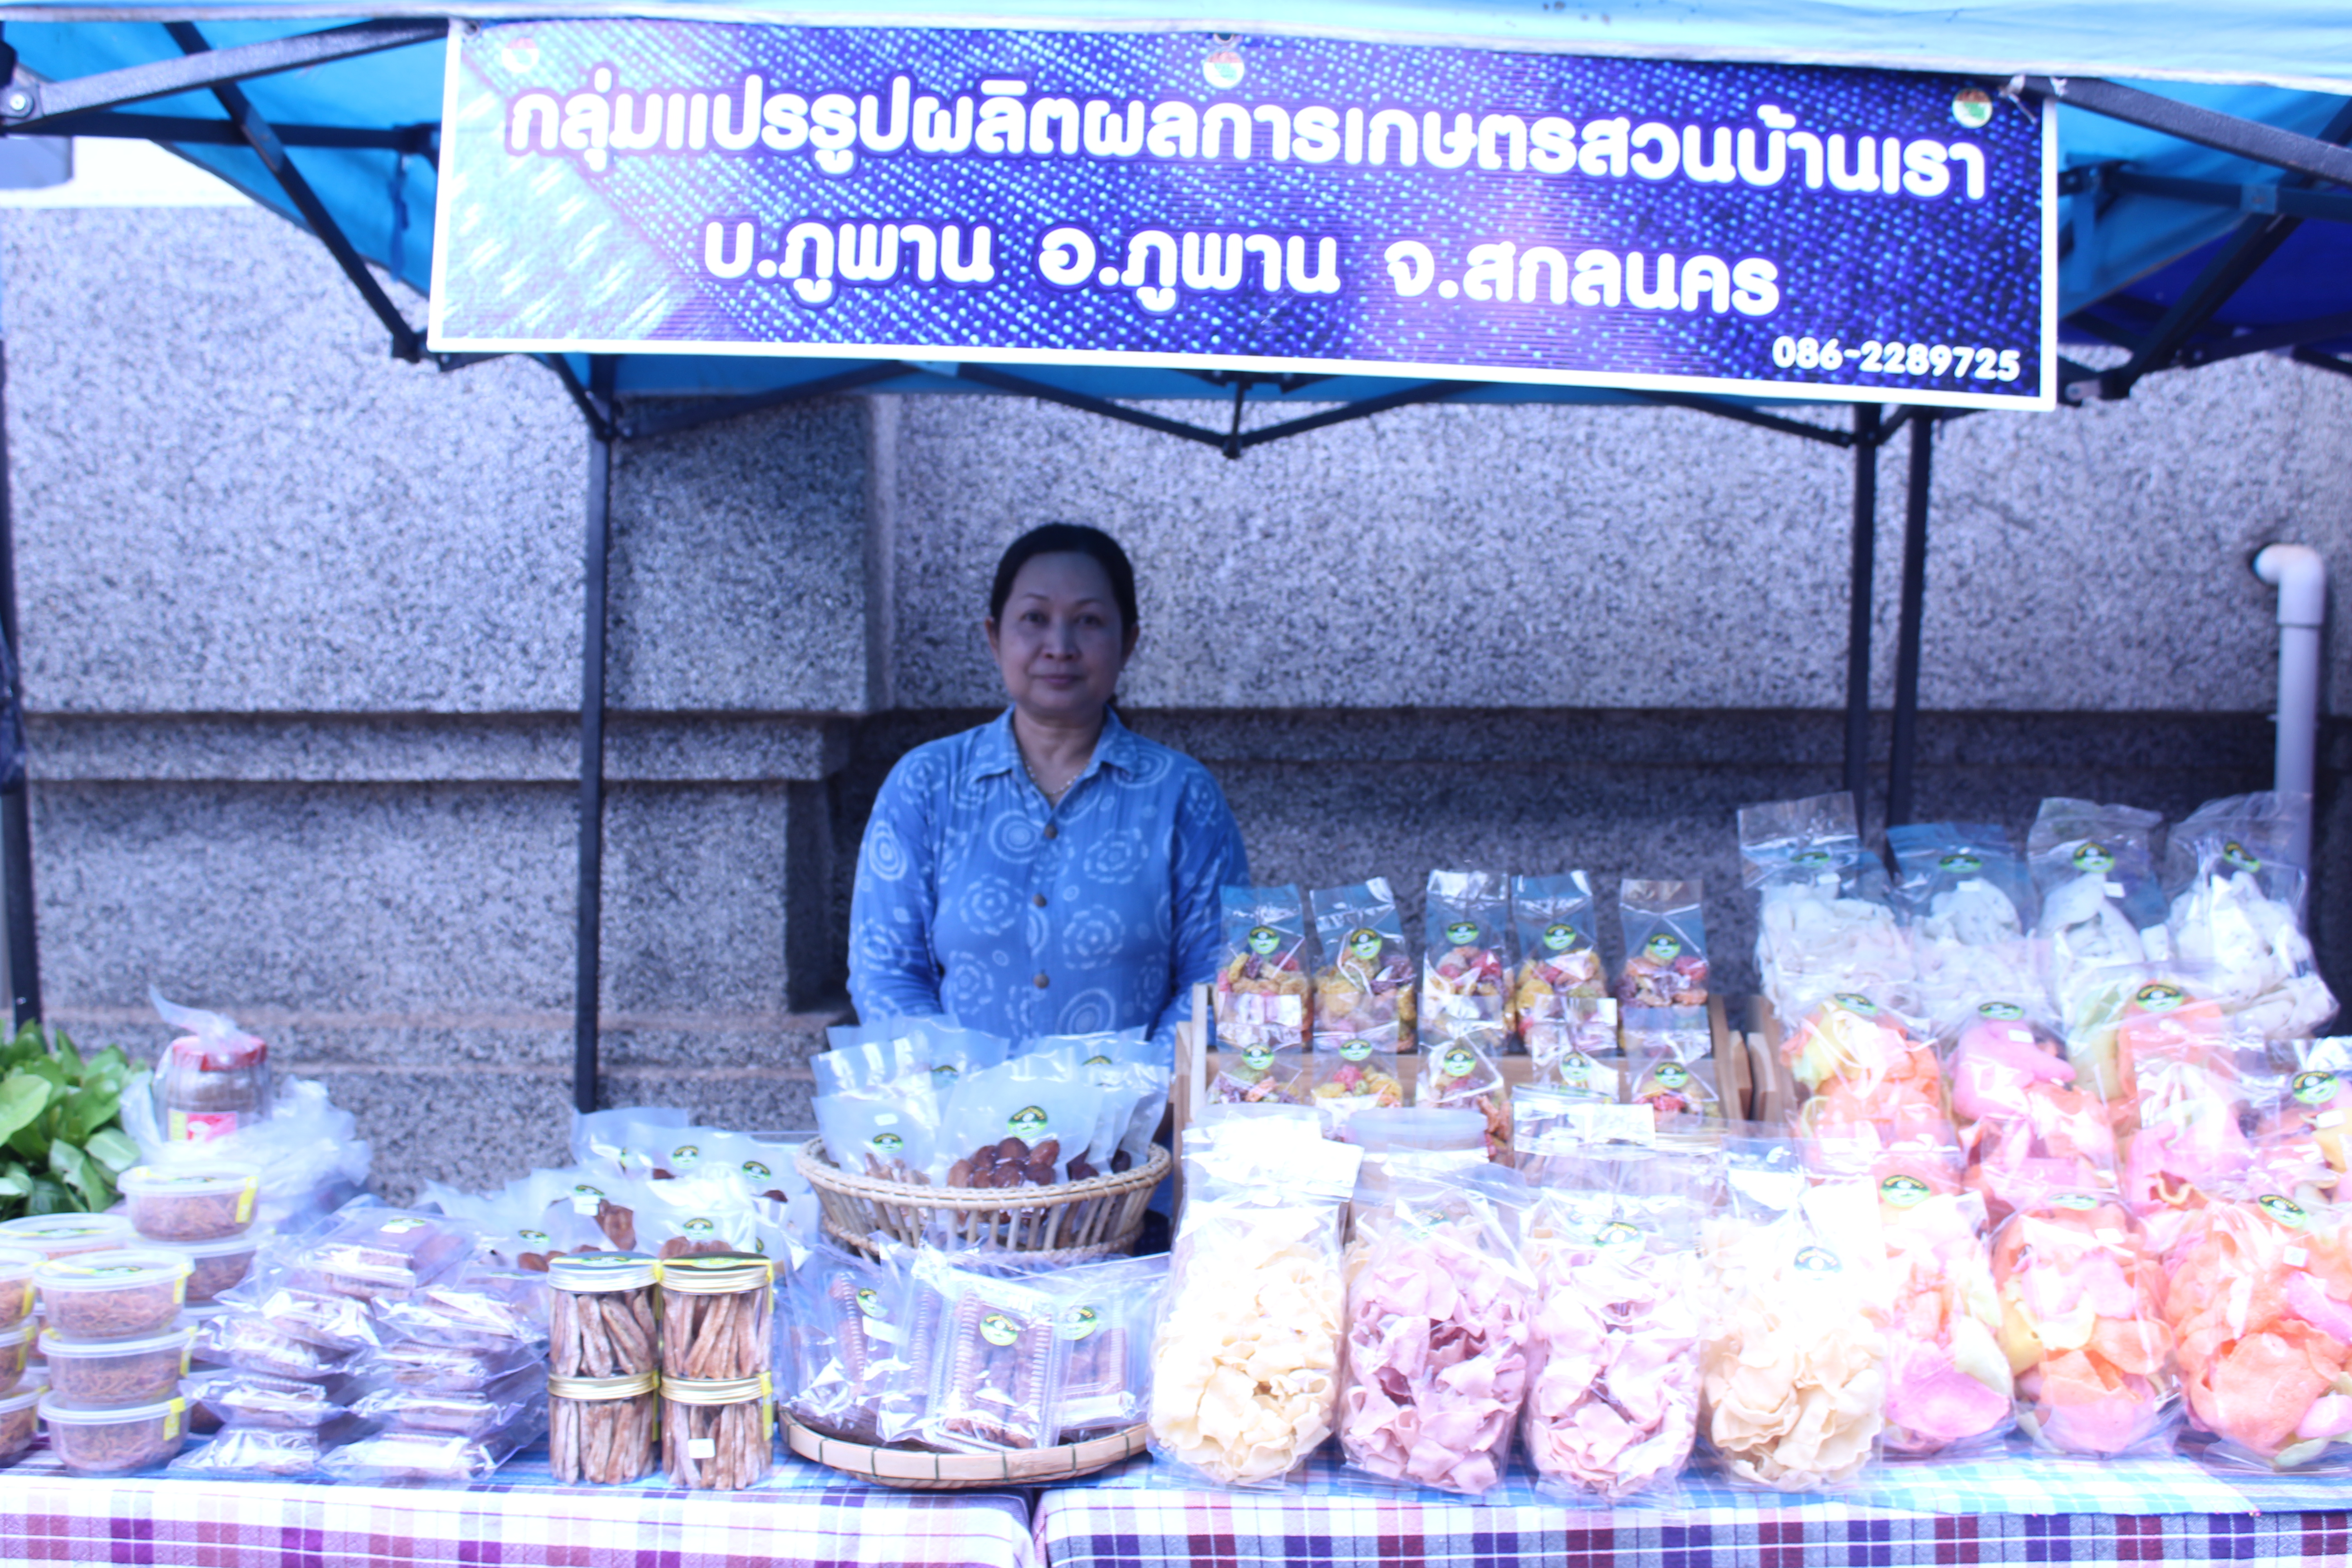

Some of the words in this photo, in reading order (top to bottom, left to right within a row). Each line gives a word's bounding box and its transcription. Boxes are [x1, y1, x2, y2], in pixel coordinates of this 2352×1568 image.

[704, 221, 995, 302] บ.ภูพาน
[1039, 226, 1341, 314] อ.ภูพาน
[1384, 240, 1780, 315] จ.สกลนคร
[1773, 336, 2020, 381] 086-2289725
